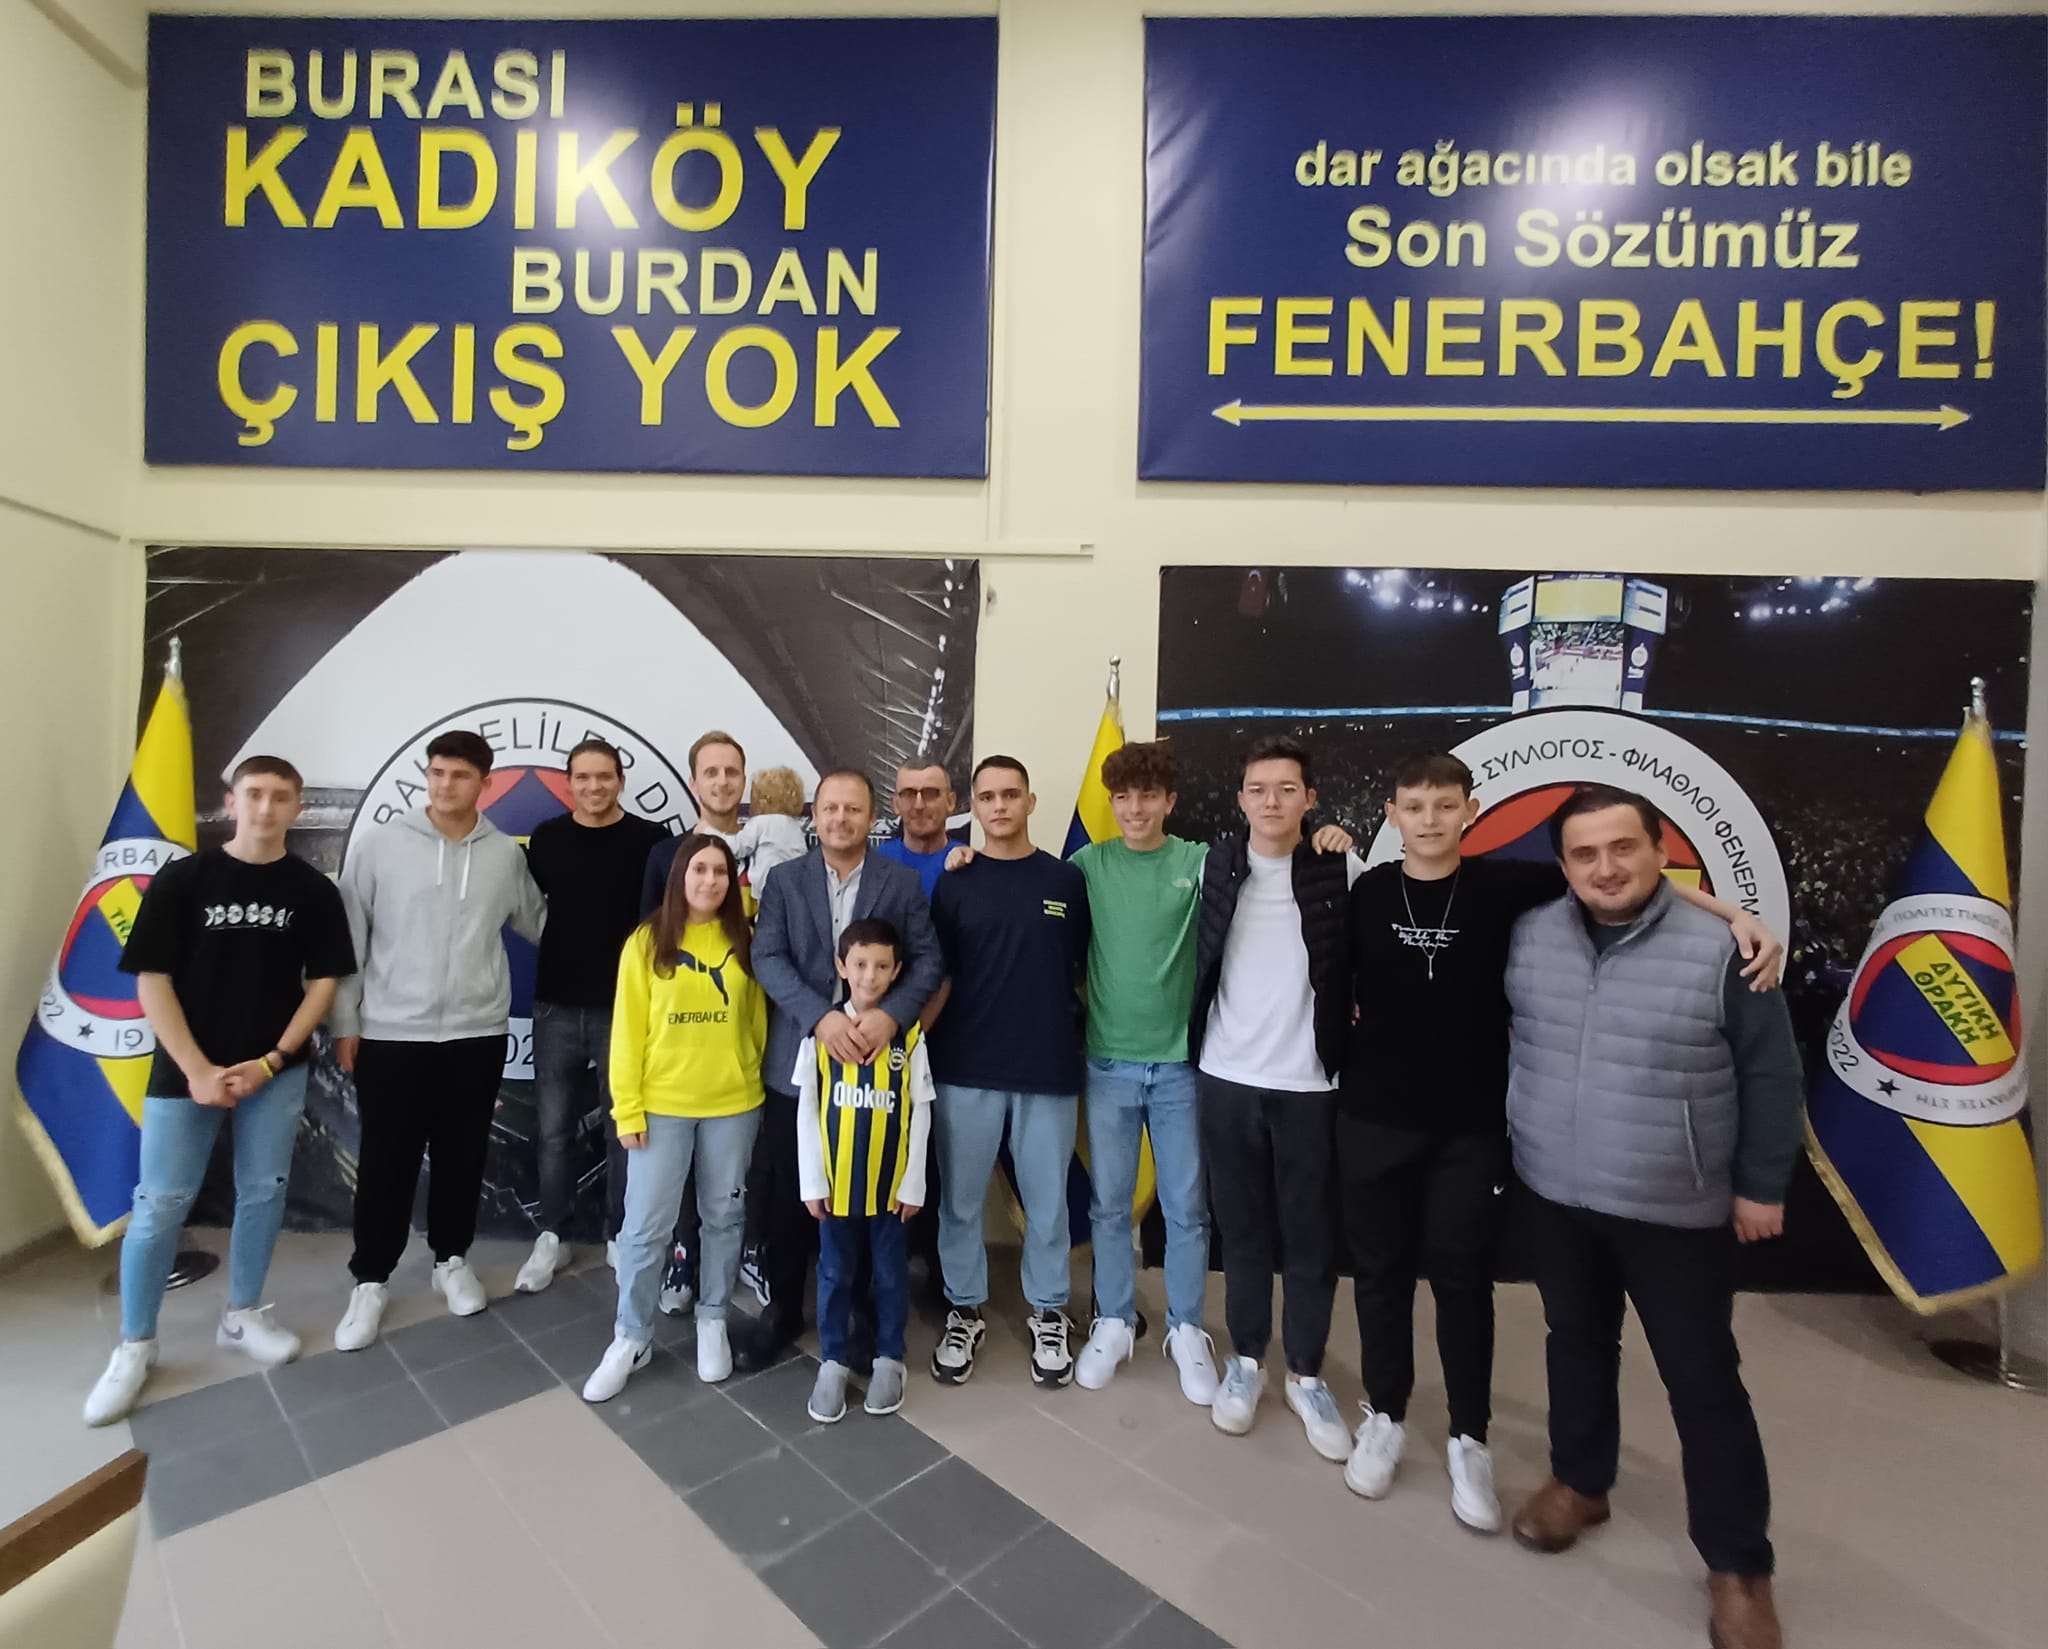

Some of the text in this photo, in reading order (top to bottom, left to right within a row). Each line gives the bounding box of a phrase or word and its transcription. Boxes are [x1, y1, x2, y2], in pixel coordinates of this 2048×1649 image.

[245, 49, 566, 119] BURASI
[223, 102, 842, 233] KADIKÖY
[1295, 142, 1914, 197] dar ağacında olsak bile
[1345, 206, 1861, 269] Son Sözümüz
[511, 248, 878, 316] BURDAN
[217, 320, 903, 452] ÇIKIŞ YOK
[1206, 297, 1998, 399] FENERBAHÇE!
[1480, 738, 1605, 781] ΣΥΛΛΟΓΟΣ
[1621, 747, 1721, 822] ΦΙΛΑΘΛΟΙ
[1714, 820, 1761, 917] ΦΕΝΕΡΜ
[1913, 971, 1982, 1045] ΘΡΑΚΗ
[1929, 960, 2000, 1041] ΔΥΤΙΚΗ
